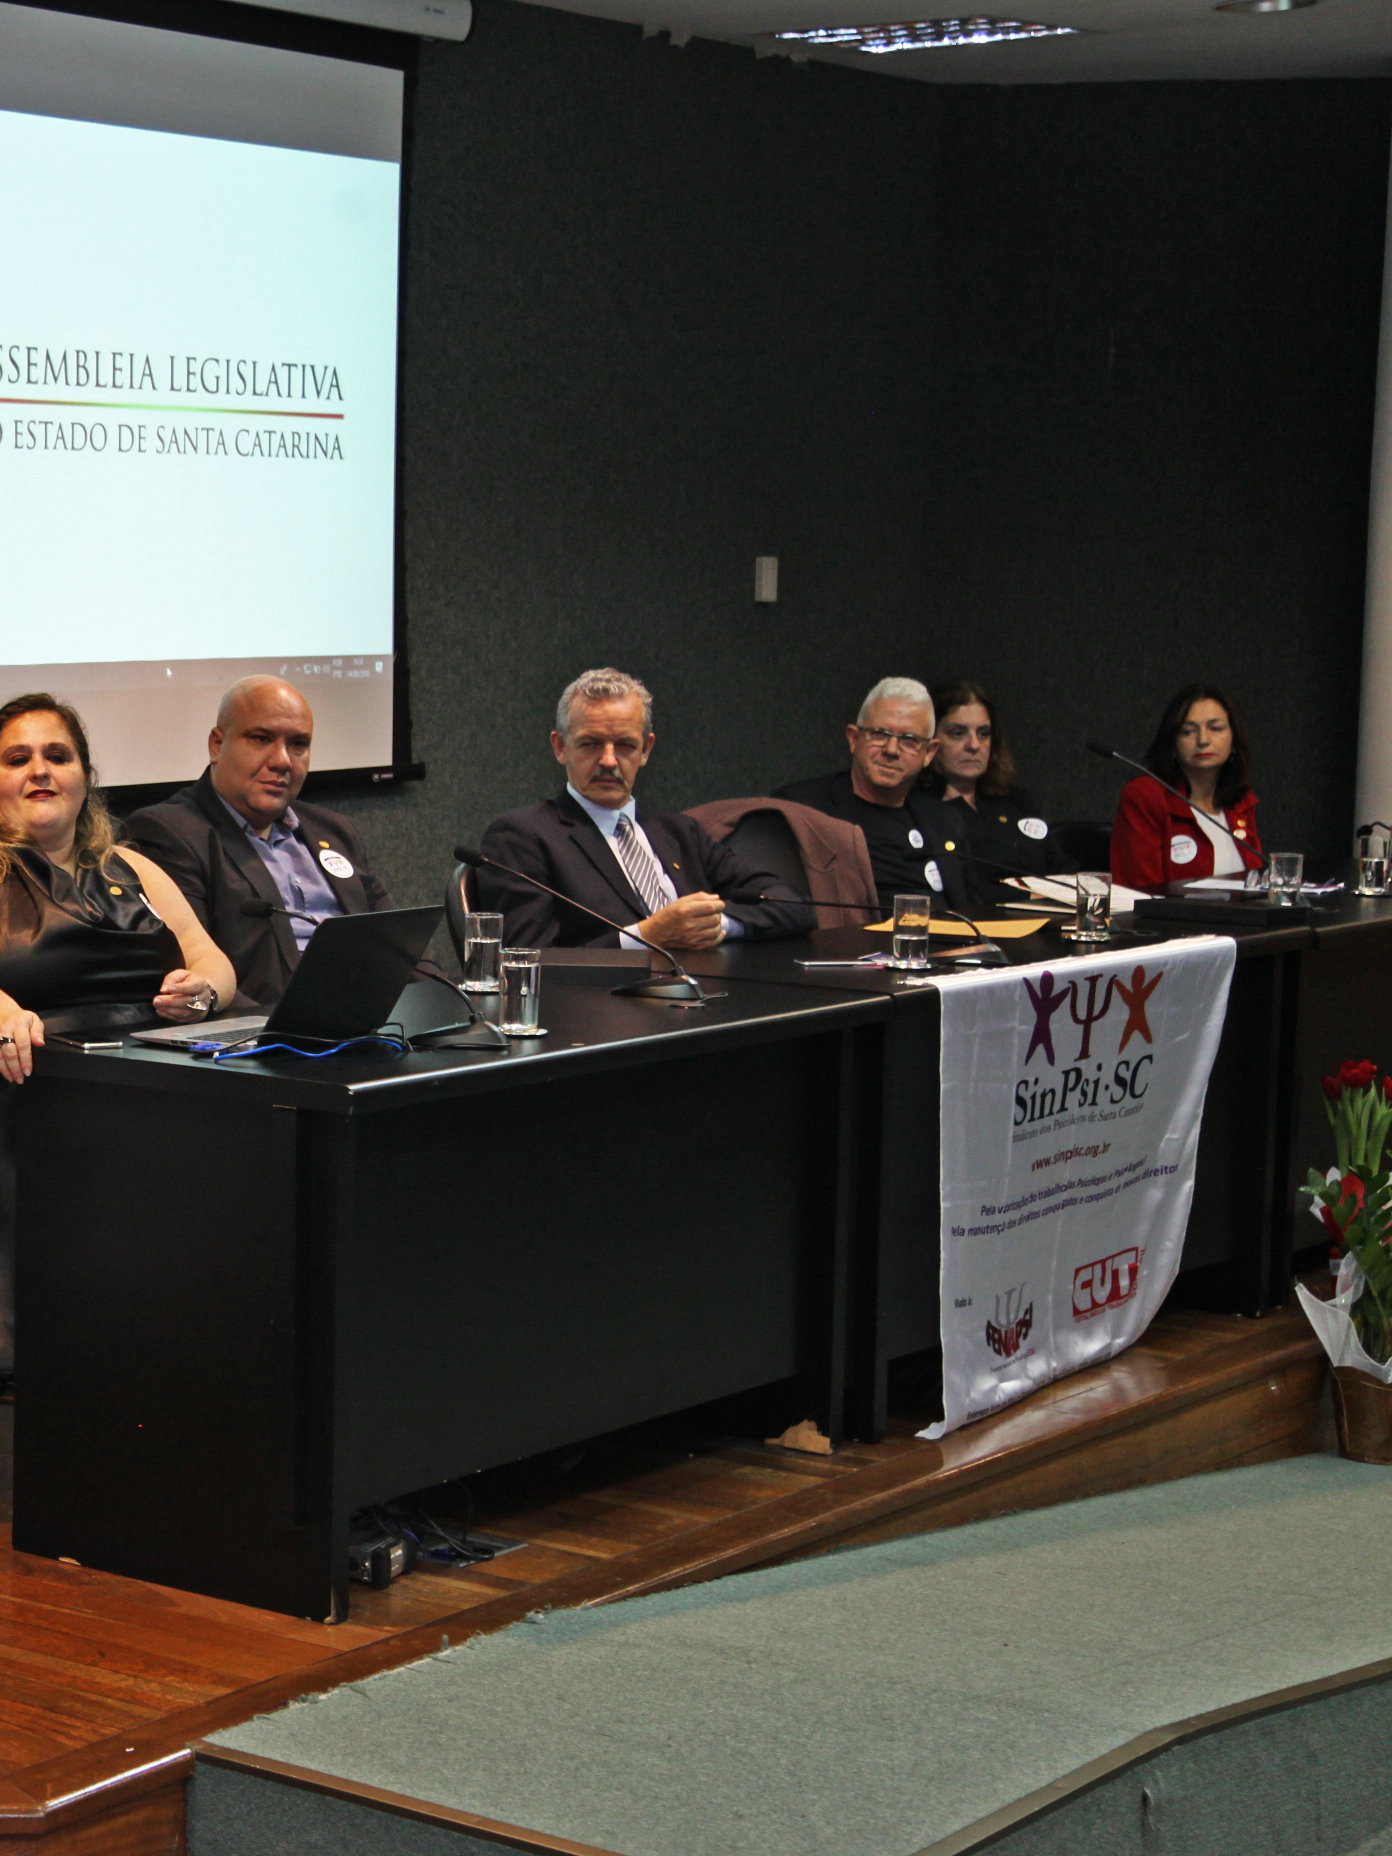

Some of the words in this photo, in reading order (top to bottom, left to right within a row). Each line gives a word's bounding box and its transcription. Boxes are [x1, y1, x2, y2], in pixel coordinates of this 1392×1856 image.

[168, 355, 344, 401] LEGISLATIVA
[13, 420, 107, 454] ESTADO
[117, 424, 148, 454] DE
[155, 427, 229, 457] SANTA
[234, 430, 344, 461] CATARINA
